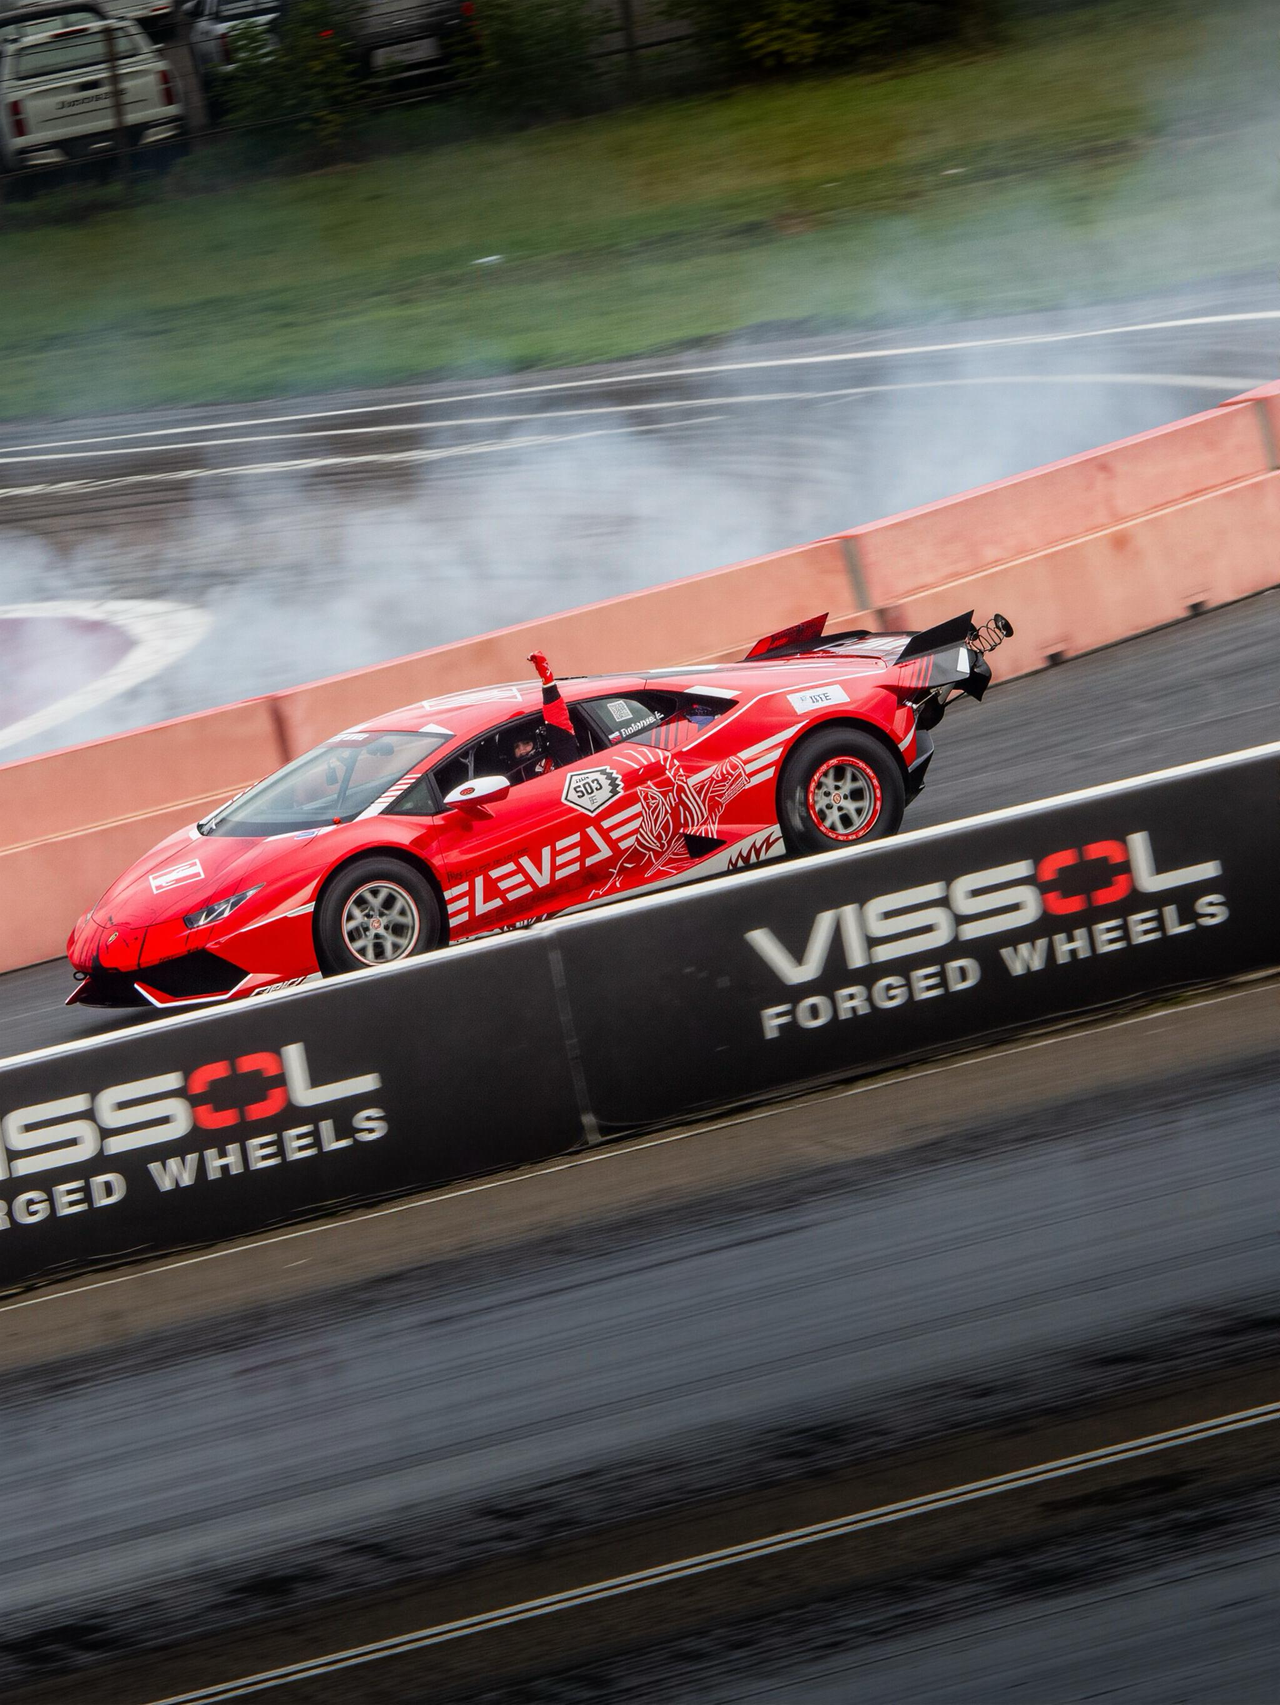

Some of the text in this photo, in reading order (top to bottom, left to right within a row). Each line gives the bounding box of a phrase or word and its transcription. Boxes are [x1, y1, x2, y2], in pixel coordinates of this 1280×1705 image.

[573, 778, 603, 799] 503
[744, 831, 1223, 986] VISSOL
[760, 893, 1230, 1040] FORGED WHEELS
[147, 1108, 389, 1192] WHEELS
